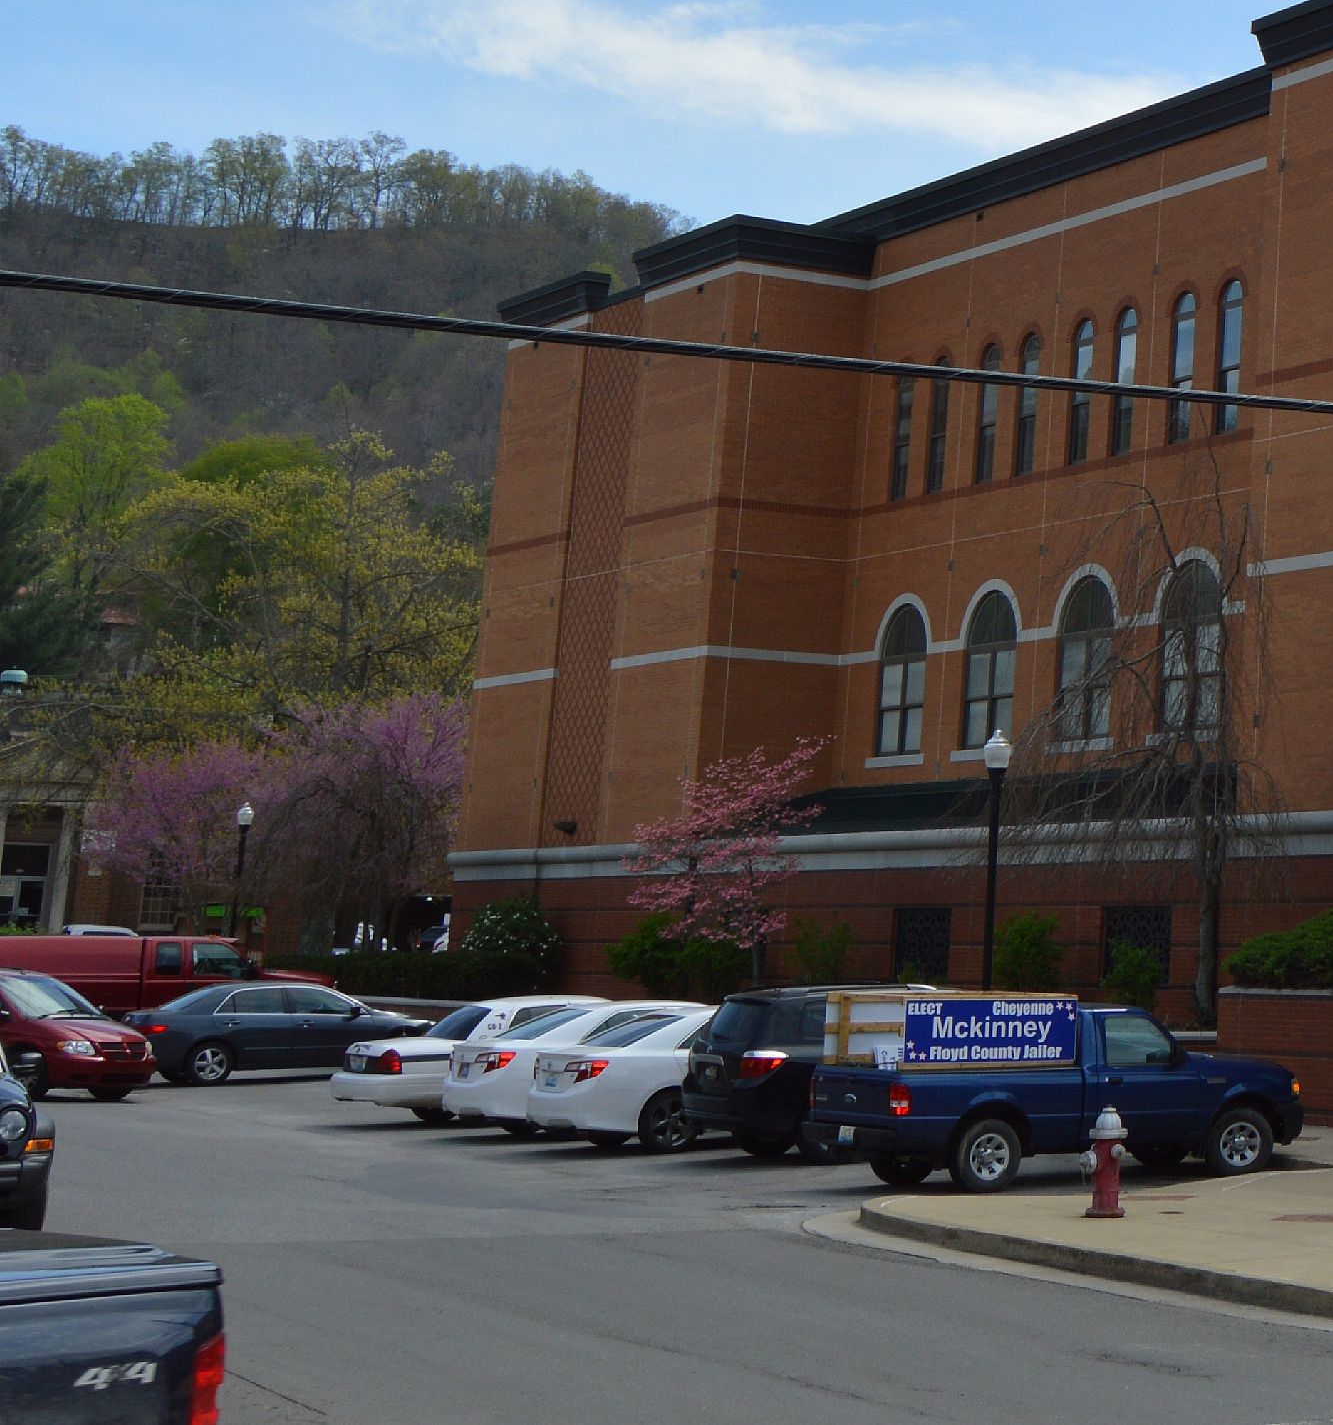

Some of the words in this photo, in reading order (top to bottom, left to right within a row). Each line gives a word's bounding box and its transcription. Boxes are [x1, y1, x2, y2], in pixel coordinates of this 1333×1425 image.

[908, 1003, 942, 1016] ELECT
[992, 1001, 1054, 1017] Cheyenne
[932, 1016, 1052, 1042] Mckinney
[929, 1045, 968, 1061] Floyd
[971, 1045, 1022, 1061] County
[1023, 1044, 1063, 1059] Jailer
